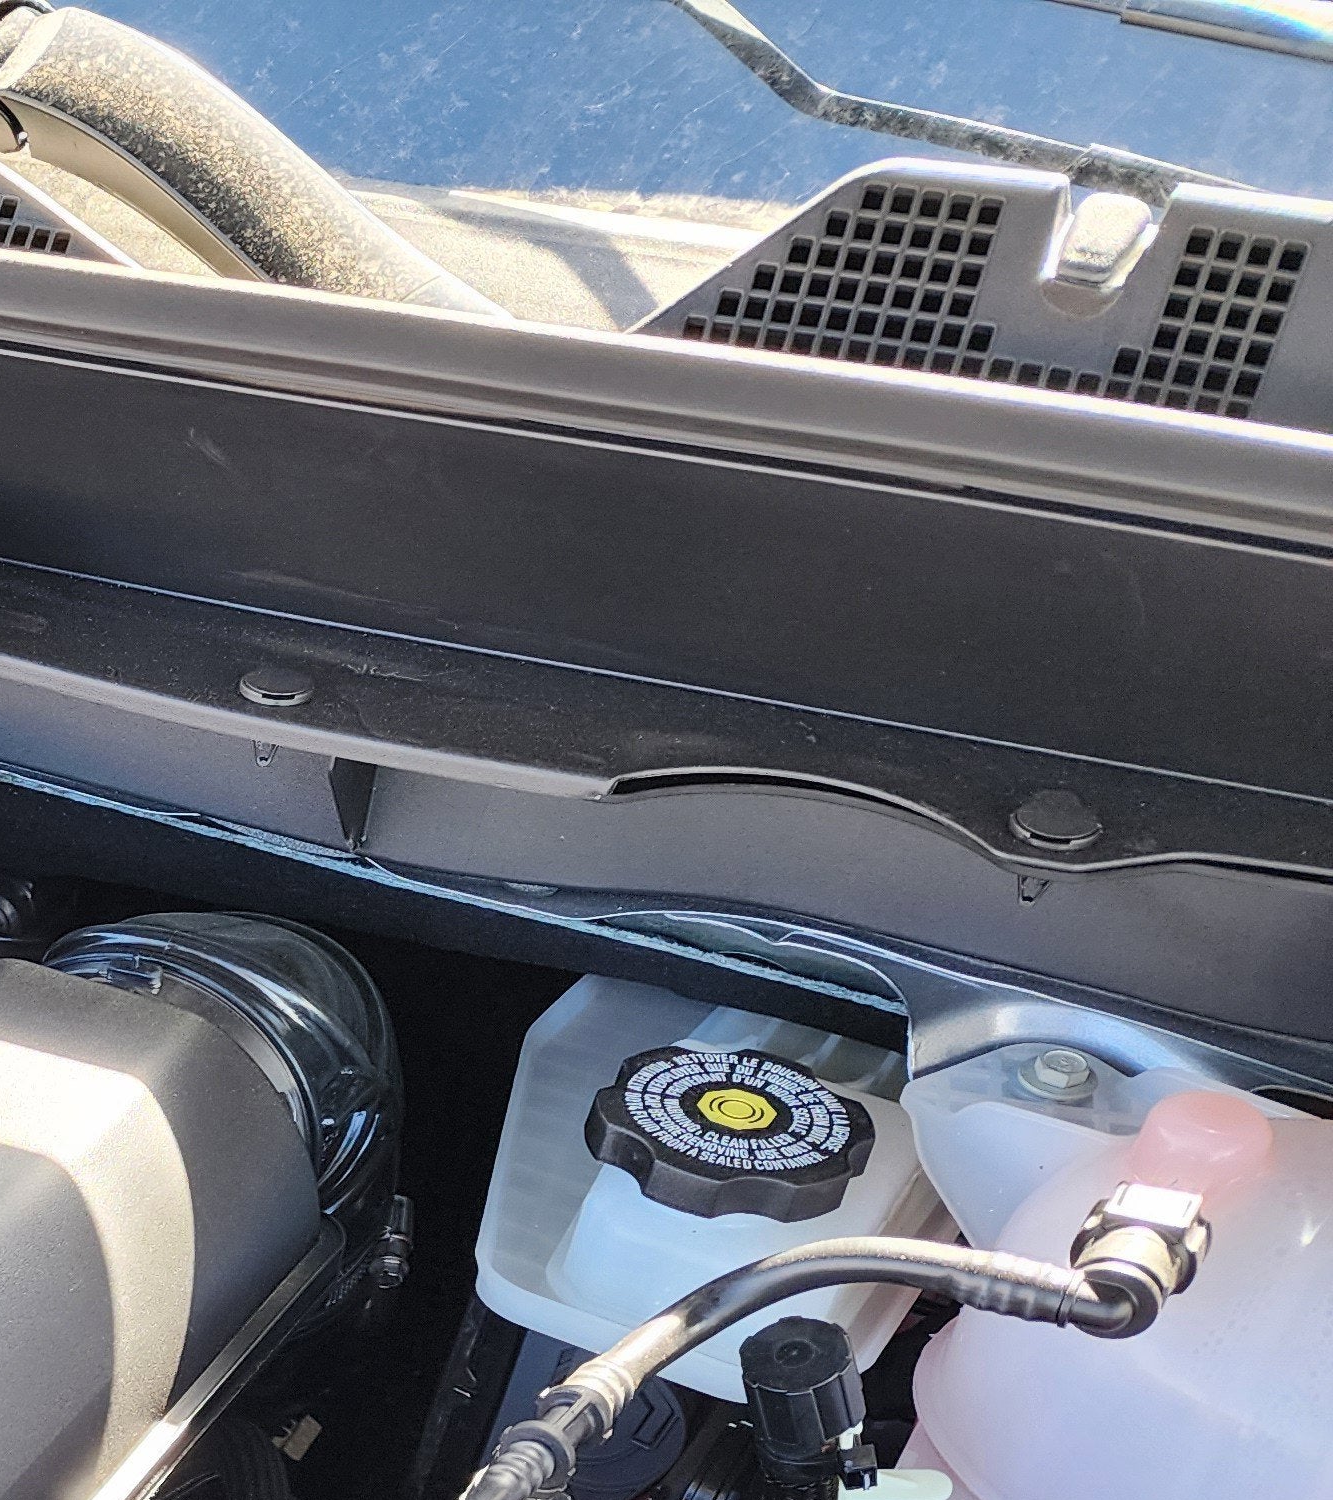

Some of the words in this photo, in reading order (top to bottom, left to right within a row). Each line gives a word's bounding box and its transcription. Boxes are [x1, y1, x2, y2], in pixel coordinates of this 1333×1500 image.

[704, 1131, 749, 1149] CLEAN
[683, 1147, 702, 1158] A
[695, 1150, 753, 1168] SEALED
